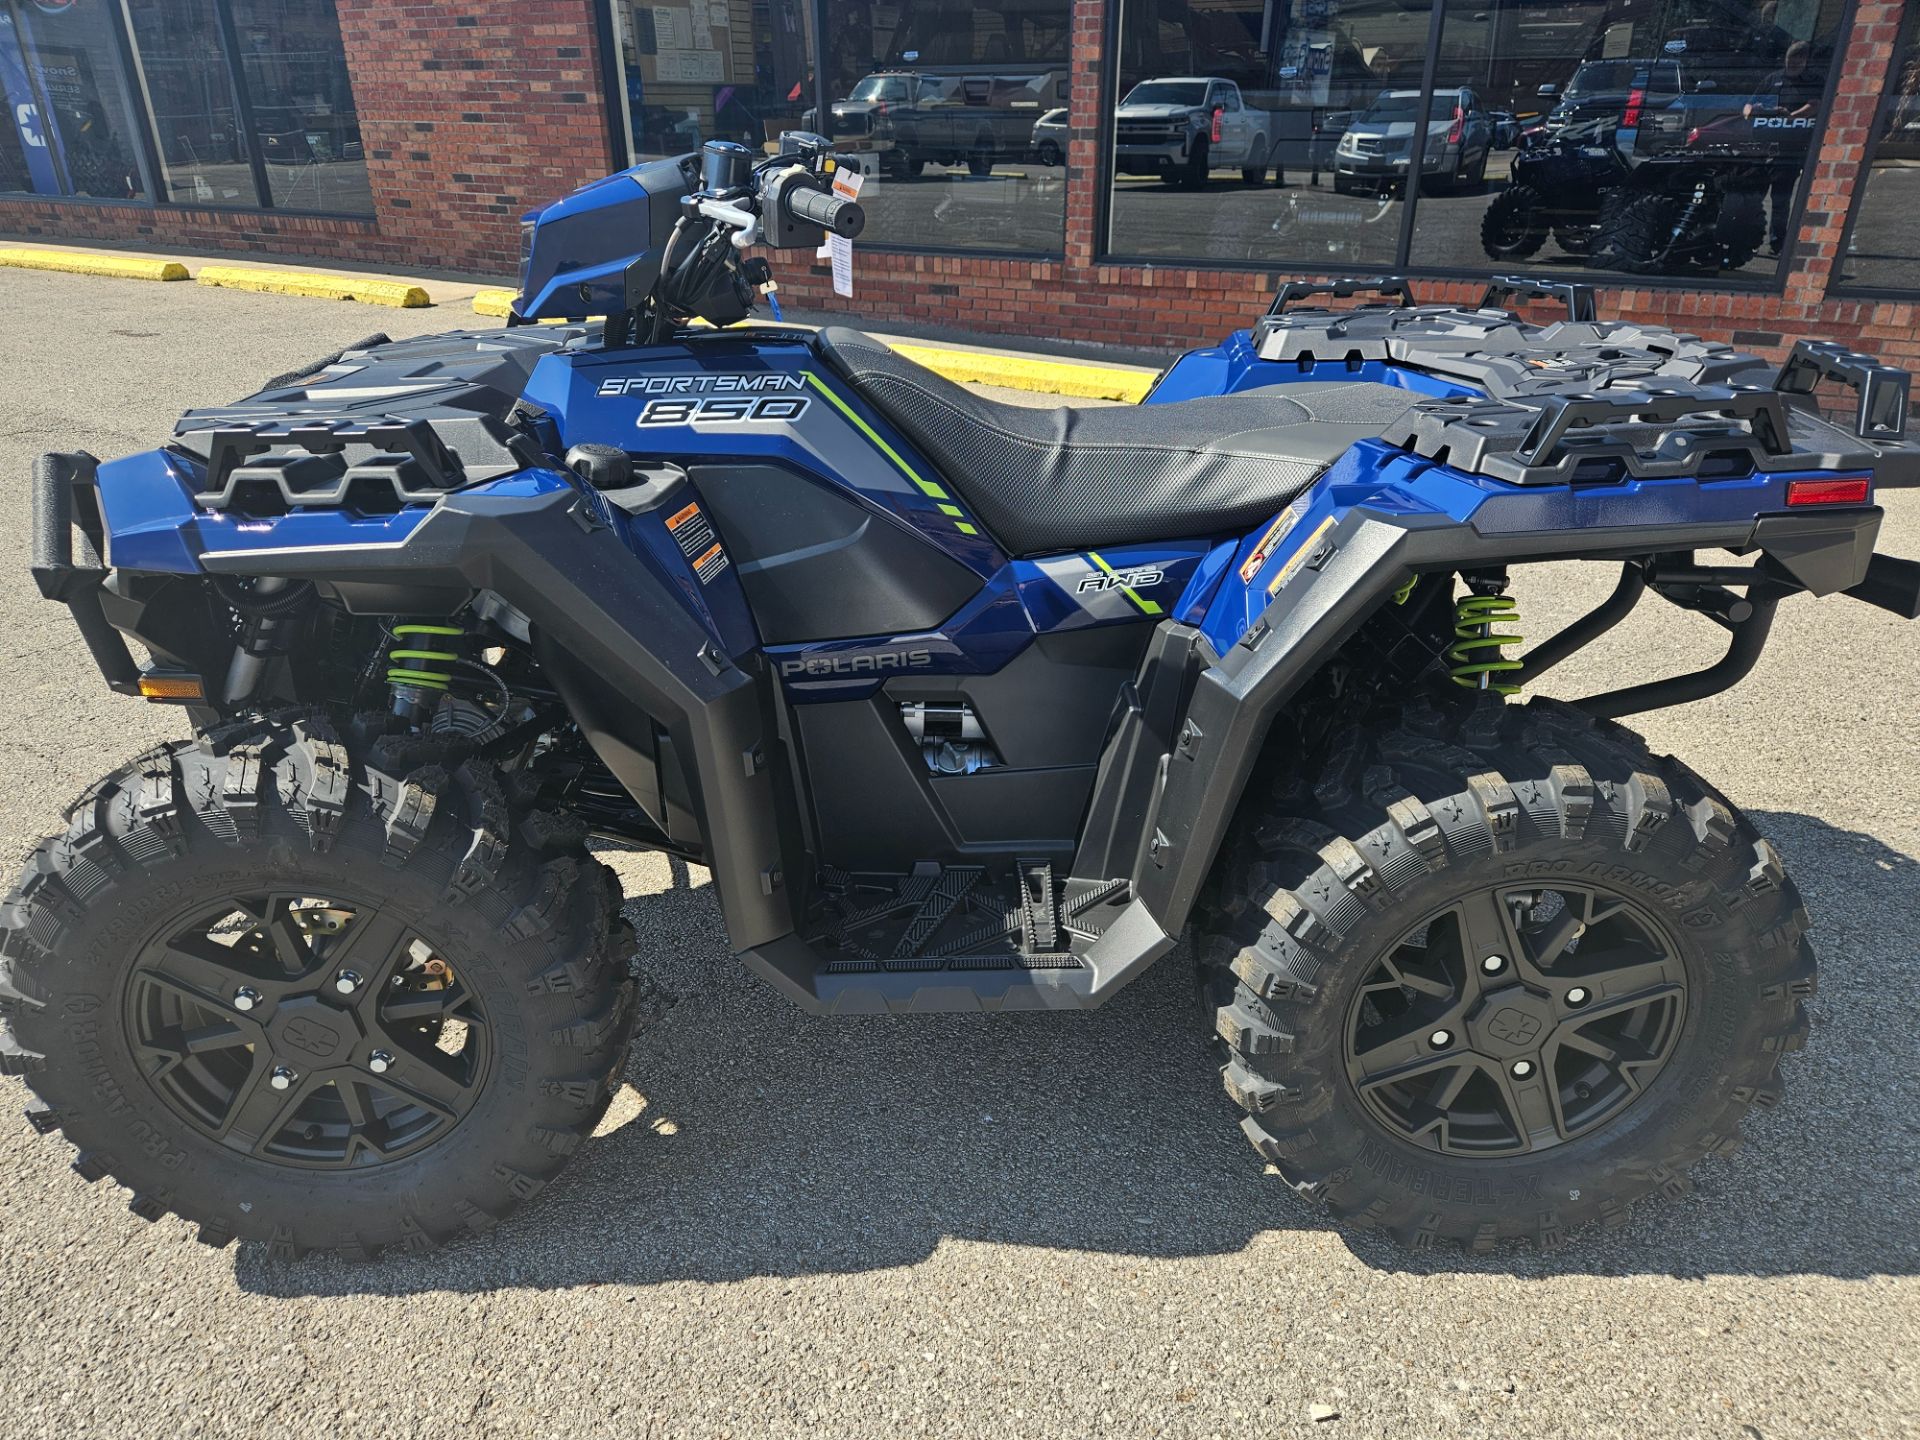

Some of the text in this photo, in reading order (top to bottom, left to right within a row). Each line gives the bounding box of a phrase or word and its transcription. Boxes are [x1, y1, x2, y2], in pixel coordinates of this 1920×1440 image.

[598, 375, 807, 396] SPORTSMAN
[636, 396, 812, 429] 850
[1076, 570, 1164, 594] AWD
[781, 649, 932, 677] POLARIS
[1356, 1137, 1545, 1206] X-TERRAIN
